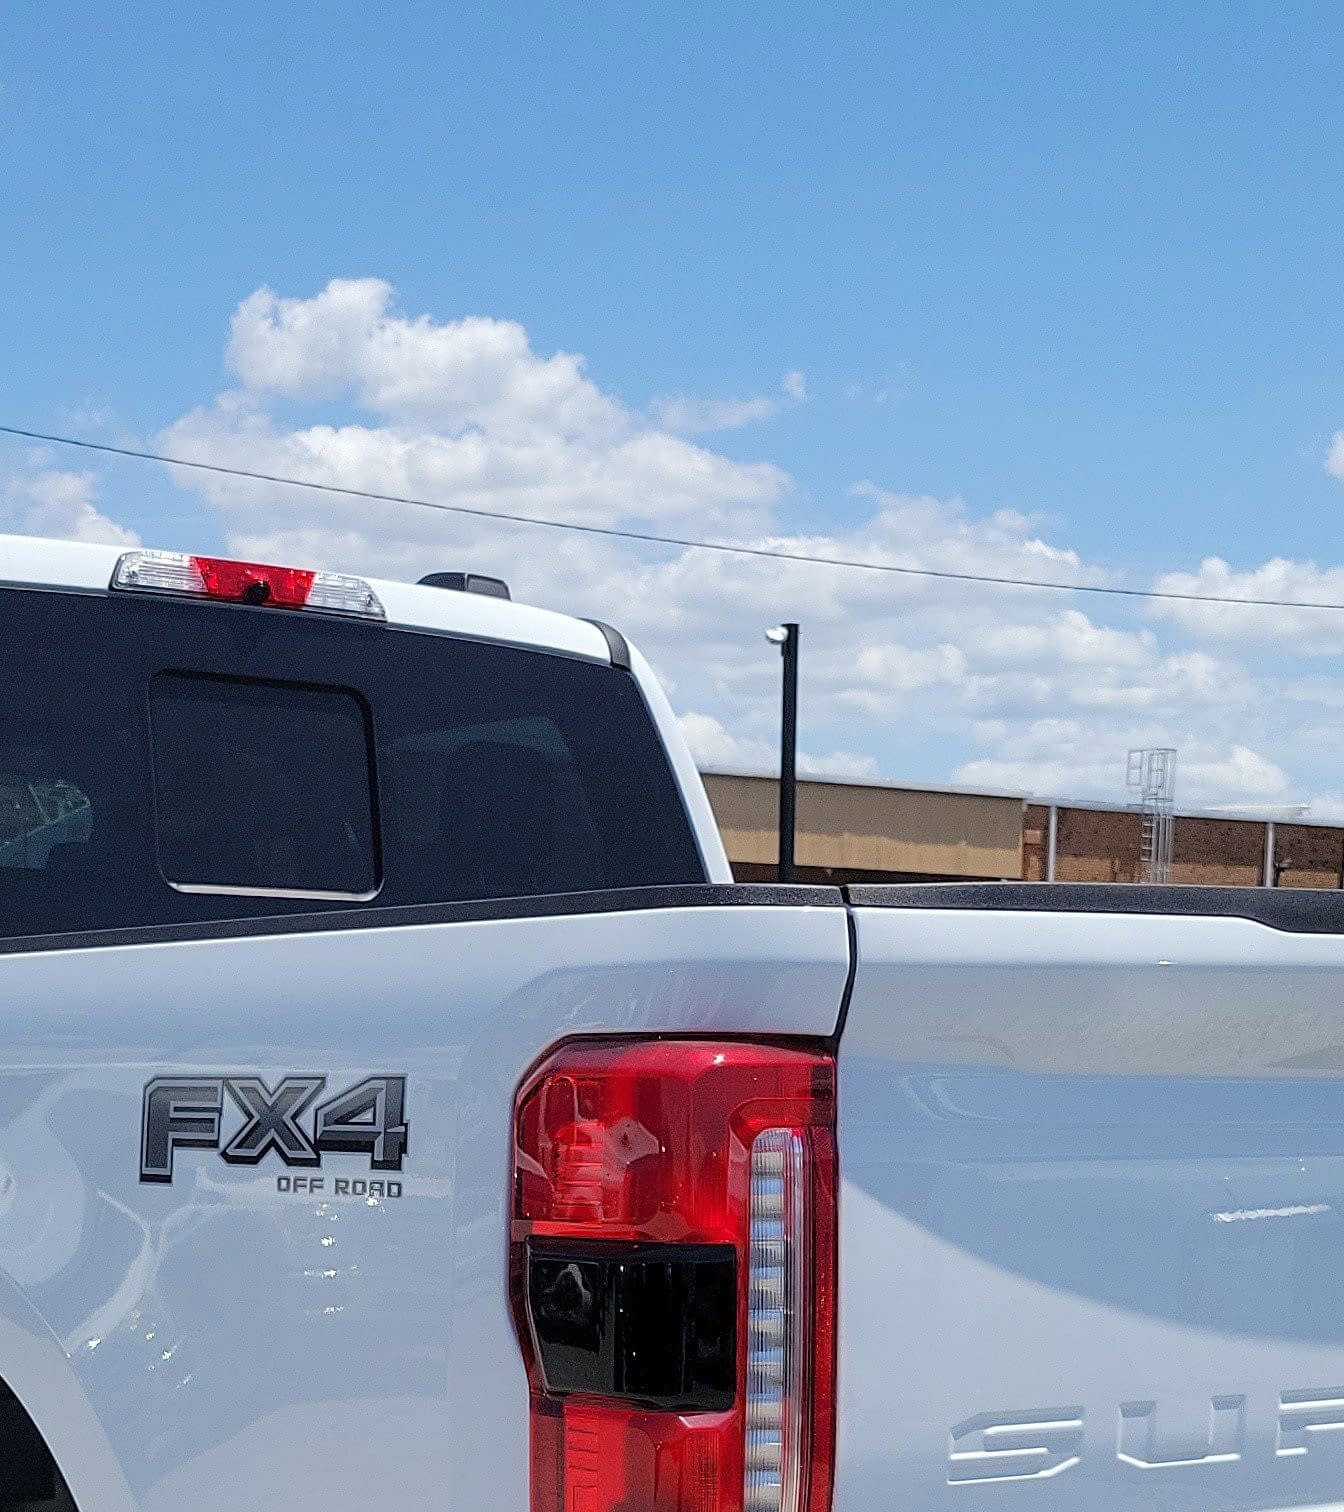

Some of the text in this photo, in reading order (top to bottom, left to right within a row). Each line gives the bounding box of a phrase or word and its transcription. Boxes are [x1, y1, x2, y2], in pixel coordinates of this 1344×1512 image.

[139, 1074, 408, 1184] FX4
[276, 1176, 402, 1199] OFF ROAD
